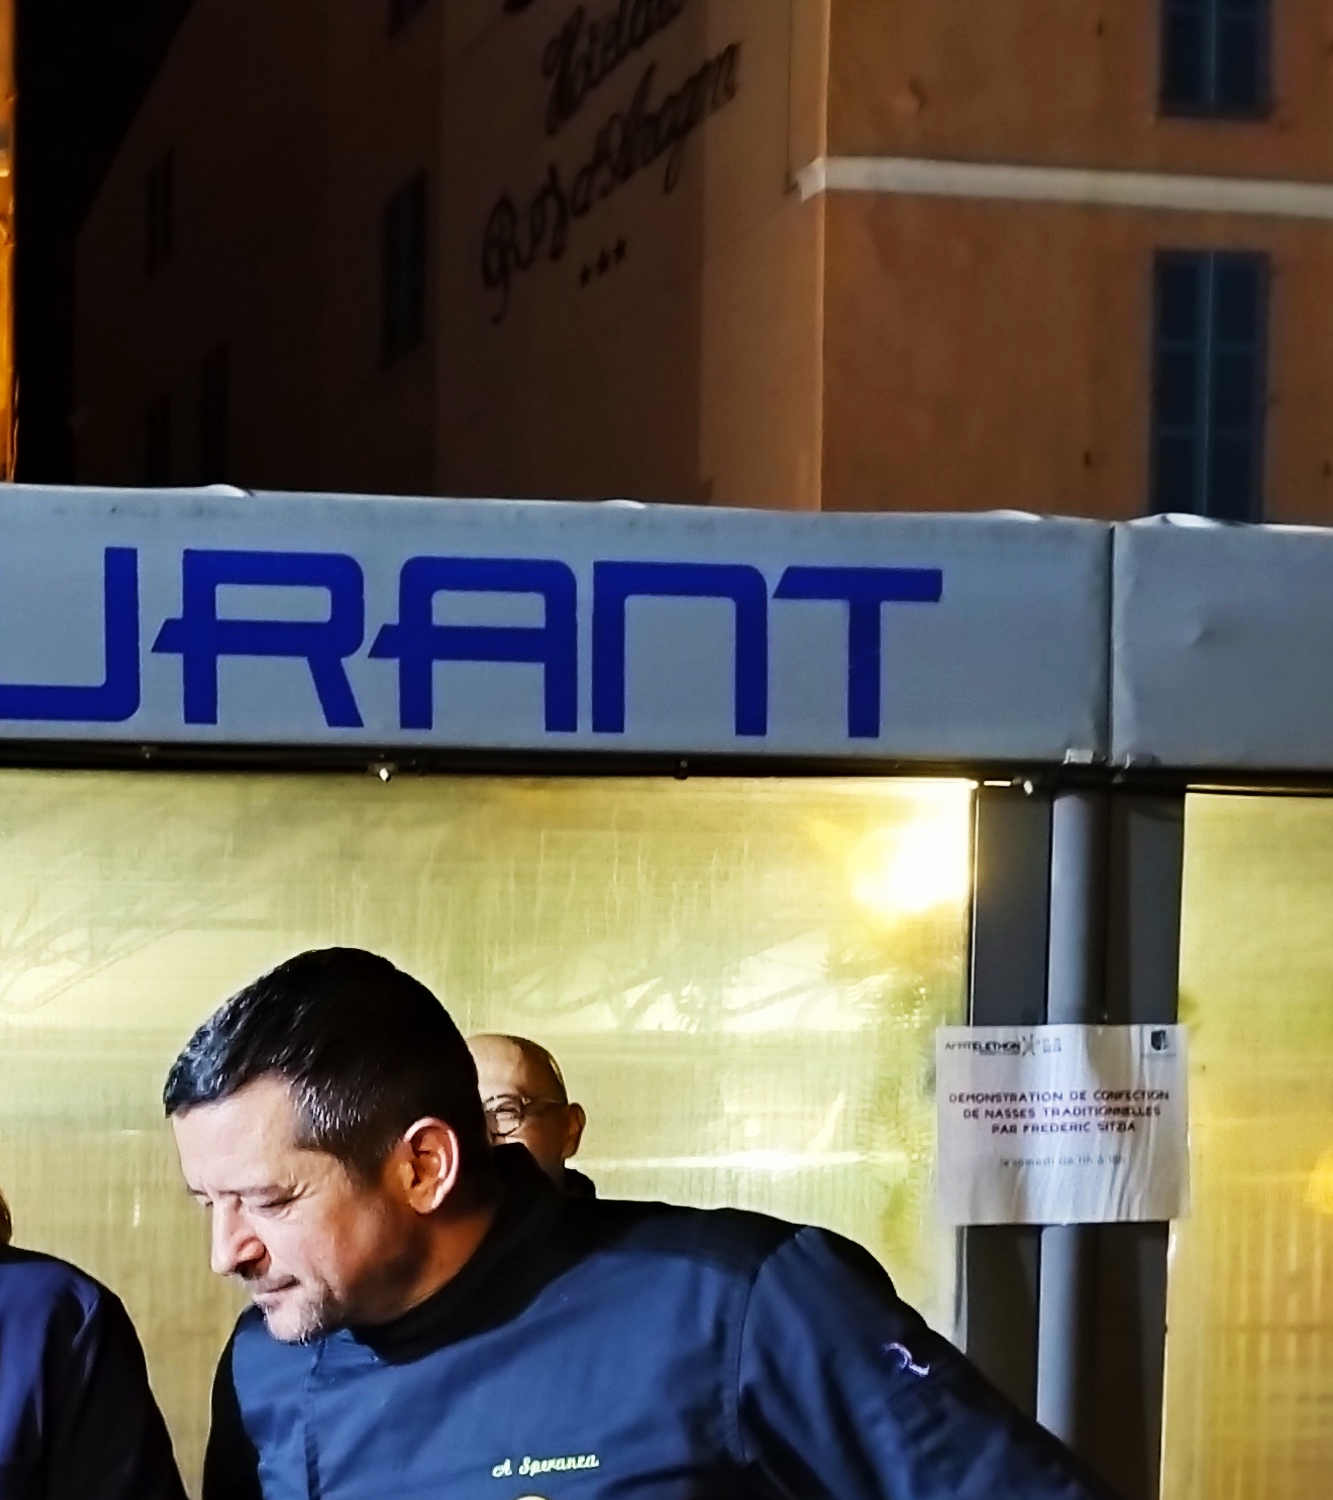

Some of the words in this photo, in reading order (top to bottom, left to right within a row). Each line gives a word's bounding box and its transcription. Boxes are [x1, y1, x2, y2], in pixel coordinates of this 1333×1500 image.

[1069, 1090, 1087, 1101] DE
[1093, 1089, 1170, 1102] CONFECTION
[962, 1108, 980, 1119] DE
[985, 1107, 1036, 1119] NASSES
[1044, 1106, 1161, 1118] TRADITIONNELLES
[991, 1123, 1018, 1135] PAR
